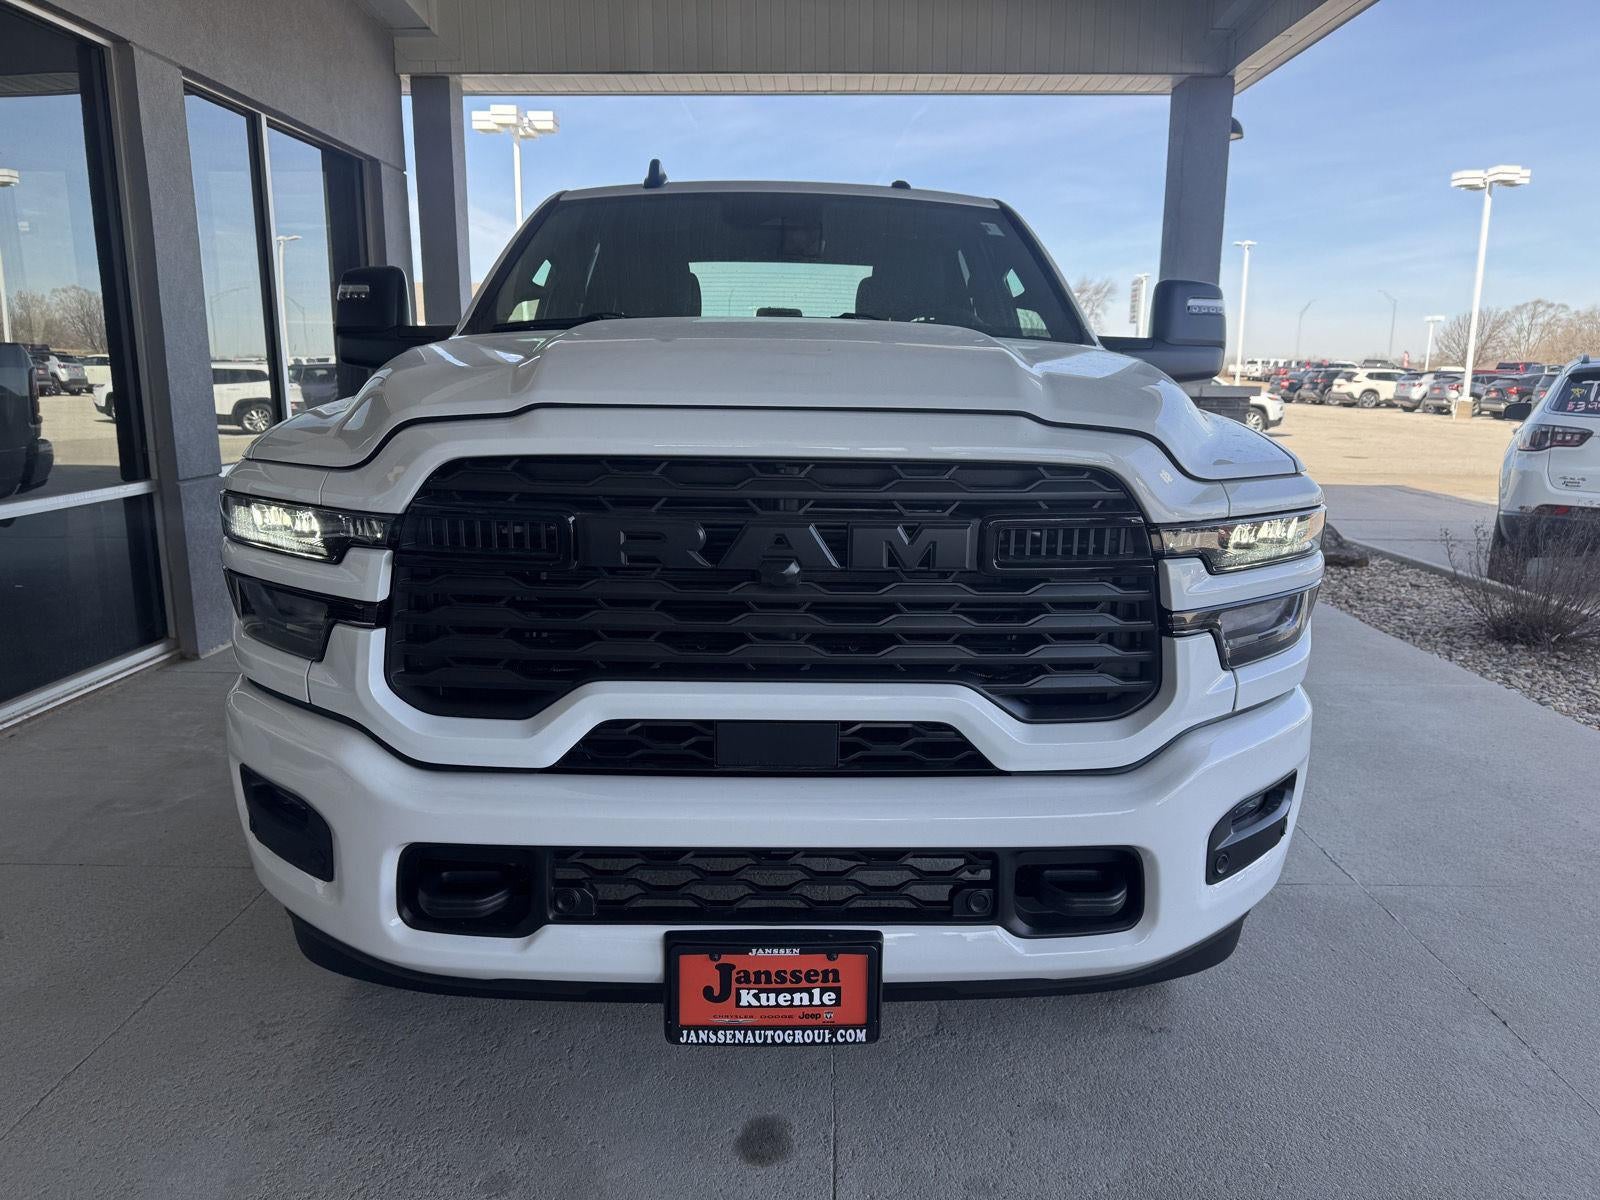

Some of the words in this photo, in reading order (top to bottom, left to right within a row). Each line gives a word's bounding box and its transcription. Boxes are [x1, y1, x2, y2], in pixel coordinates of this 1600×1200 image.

[579, 513, 980, 571] RAM
[749, 948, 800, 956] JANSSEN
[703, 963, 841, 1003] Janssen
[739, 988, 836, 1007] Kuenle
[798, 1011, 821, 1021] Jeep
[680, 1029, 867, 1044] JANSSENAUTOGROUP.COM
